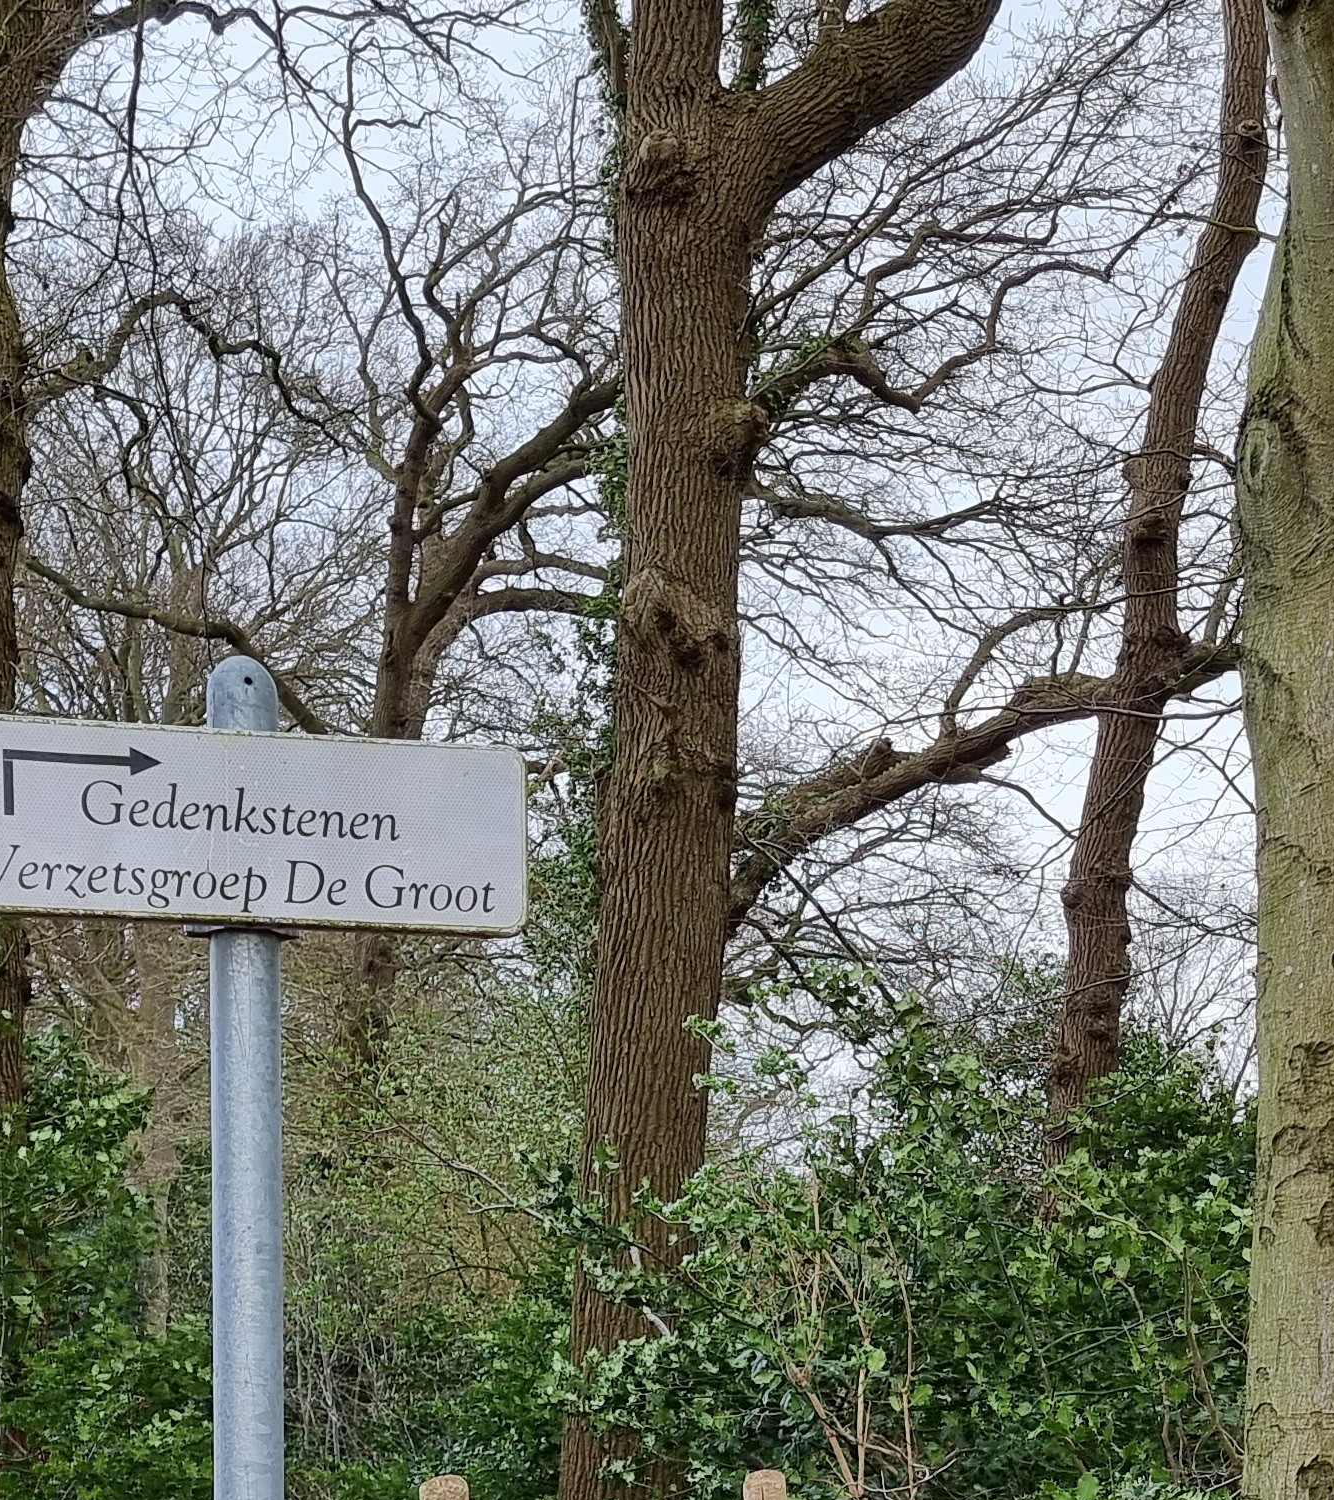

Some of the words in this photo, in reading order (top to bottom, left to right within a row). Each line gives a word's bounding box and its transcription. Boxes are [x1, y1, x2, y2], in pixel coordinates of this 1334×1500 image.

[80, 779, 400, 842] Gedenkstenen
[284, 859, 347, 906] De
[365, 864, 496, 914] Groot
